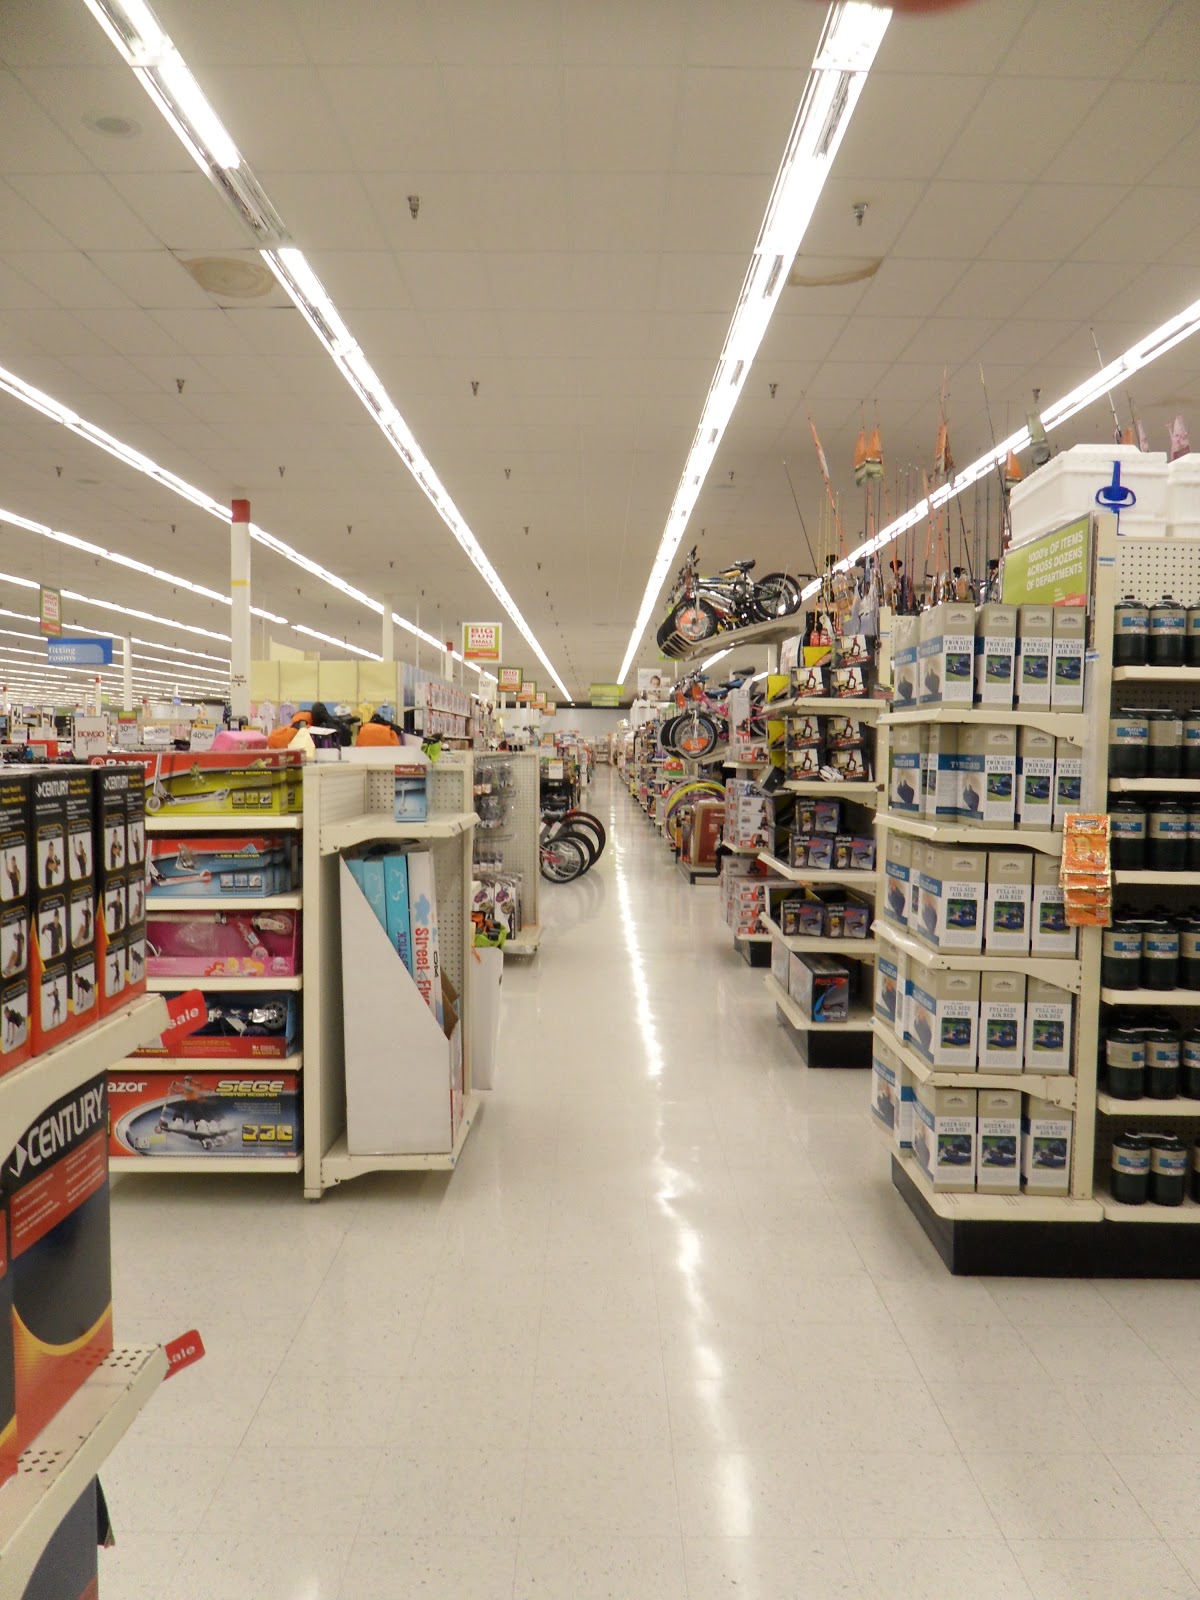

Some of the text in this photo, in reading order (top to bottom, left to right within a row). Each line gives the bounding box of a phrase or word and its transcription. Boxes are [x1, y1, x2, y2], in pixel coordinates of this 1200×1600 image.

[1028, 530, 1083, 563] 1000's OF ITEMS
[1027, 547, 1083, 577] ACROSS DOZENS
[1026, 562, 1083, 591] OF DEPARTMENTS
[49, 646, 76, 655] fitting
[77, 730, 104, 738] BONGO
[41, 780, 69, 798] CENTURY
[108, 775, 129, 791] CENTURY
[414, 928, 430, 970] Street
[168, 1007, 199, 1030] sale
[26, 1083, 104, 1167] CENTURY
[169, 1346, 195, 1363] ale
